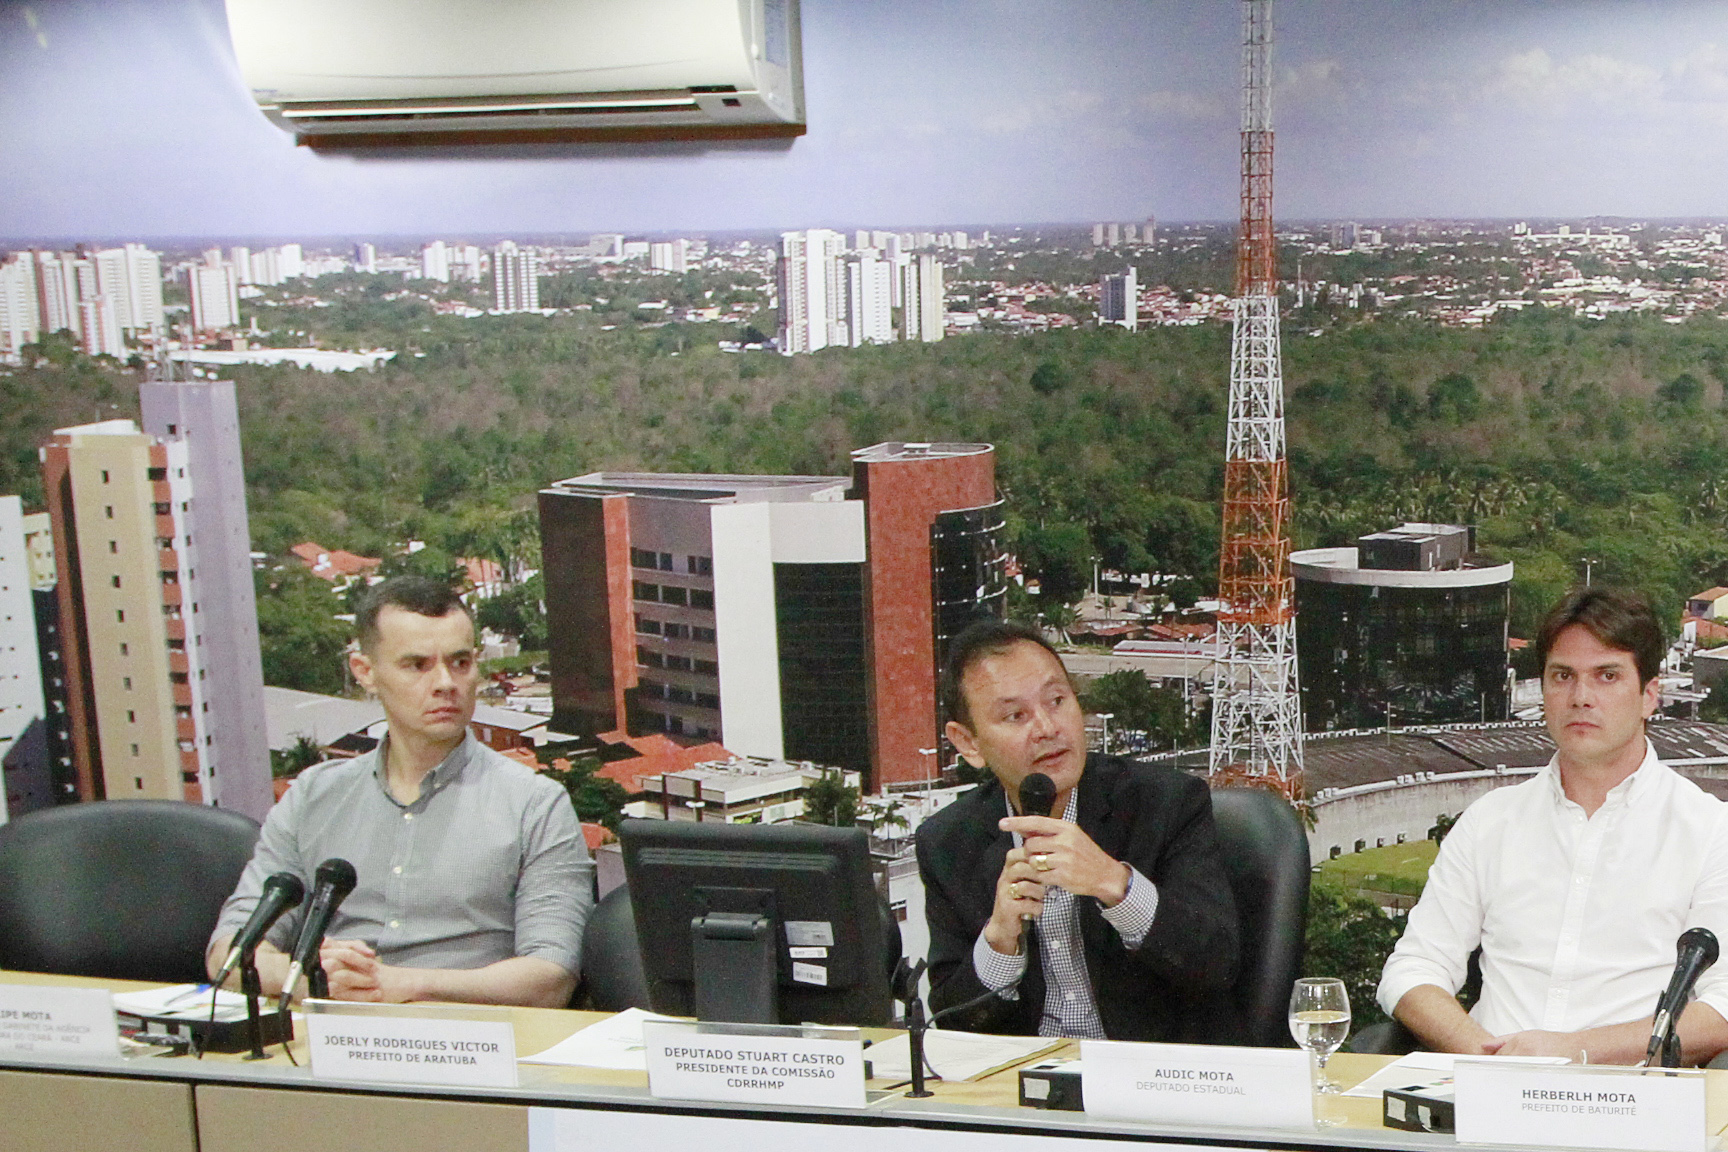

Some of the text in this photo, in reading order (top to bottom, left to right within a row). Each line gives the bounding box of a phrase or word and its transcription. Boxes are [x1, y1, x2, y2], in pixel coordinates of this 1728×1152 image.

[22, 1011, 52, 1021] MOTA
[325, 1035, 499, 1053] JOERLY RODRIGUES VICTOR
[349, 1051, 477, 1065] PREFEITO DE ARATUBA
[664, 1047, 845, 1066] DEPUTADO STUART CASTRO
[676, 1062, 835, 1079] PRESIDENTE DA COMISSÃO
[1155, 1069, 1234, 1081] AUDIC MOTA
[727, 1078, 785, 1090] CDRRHMP
[1136, 1081, 1246, 1096] DEPUTADO ESTADUAL
[1522, 1089, 1636, 1103] HERBERLH MOTA
[1522, 1103, 1637, 1116] PREFEITO DE BATURITÉ
